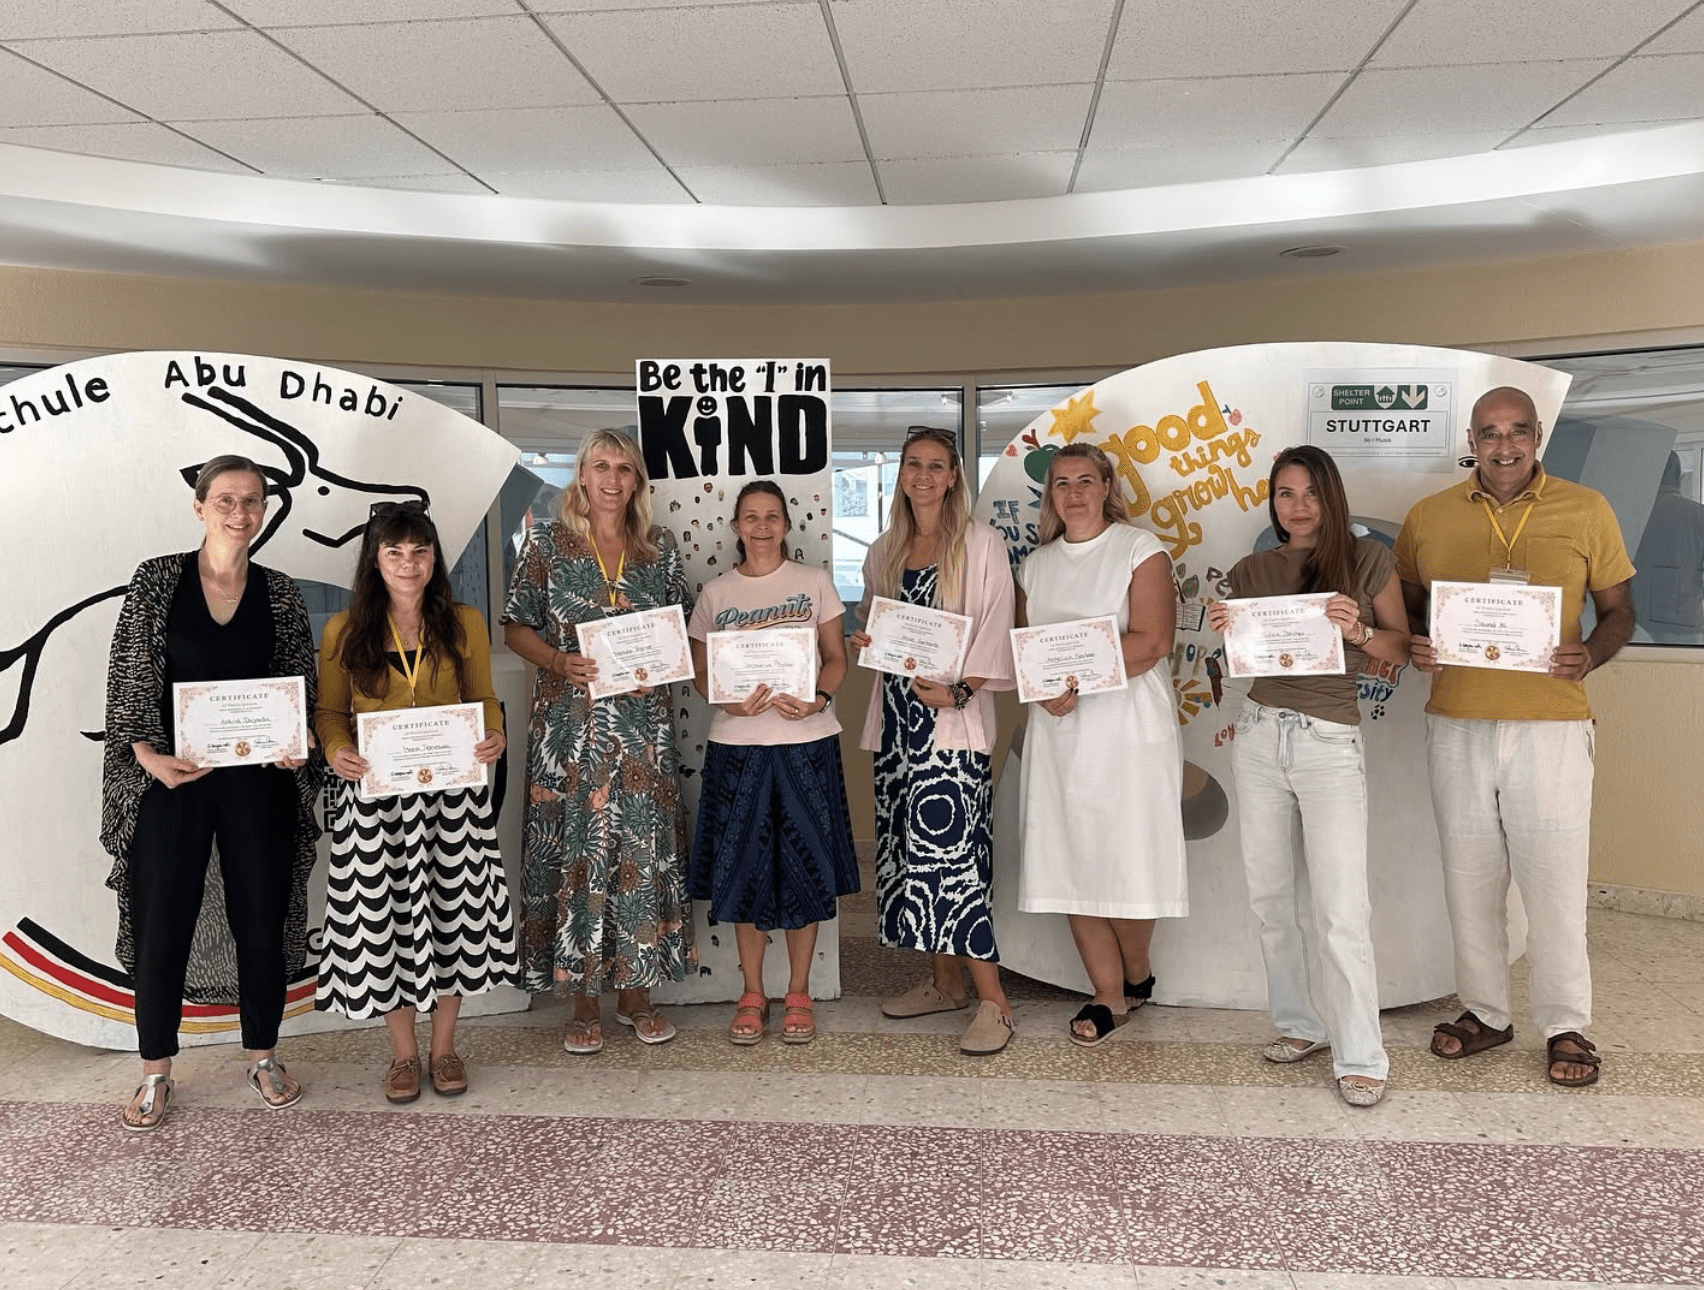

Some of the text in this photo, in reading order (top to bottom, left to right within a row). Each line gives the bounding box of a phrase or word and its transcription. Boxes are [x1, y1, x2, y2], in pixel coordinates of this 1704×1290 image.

[640, 361, 682, 393] Be
[689, 363, 746, 393] the
[795, 362, 826, 392] in
[164, 356, 246, 389] Abu
[280, 371, 403, 420] Dhabi
[1333, 389, 1371, 397] SHELTER
[1338, 397, 1365, 405] POINT
[1326, 419, 1431, 433] STUTTGART
[1098, 380, 1228, 517] good
[1170, 428, 1261, 478] things
[993, 500, 1020, 525] IF
[1151, 464, 1270, 561] grow he
[1206, 566, 1230, 598] Pe
[1464, 596, 1523, 606] CERTIFICATE
[714, 593, 813, 631] Peanuts
[1252, 608, 1306, 618] CERTIFICATE
[896, 613, 942, 628] CERTIFICATE
[606, 622, 655, 637] CERTIFICATE
[736, 641, 785, 649] CERTIFICATE
[1039, 632, 1088, 643] CERTIFICATE
[209, 693, 270, 702] CERTIFICATE
[392, 720, 450, 731] CERTIFICATE
